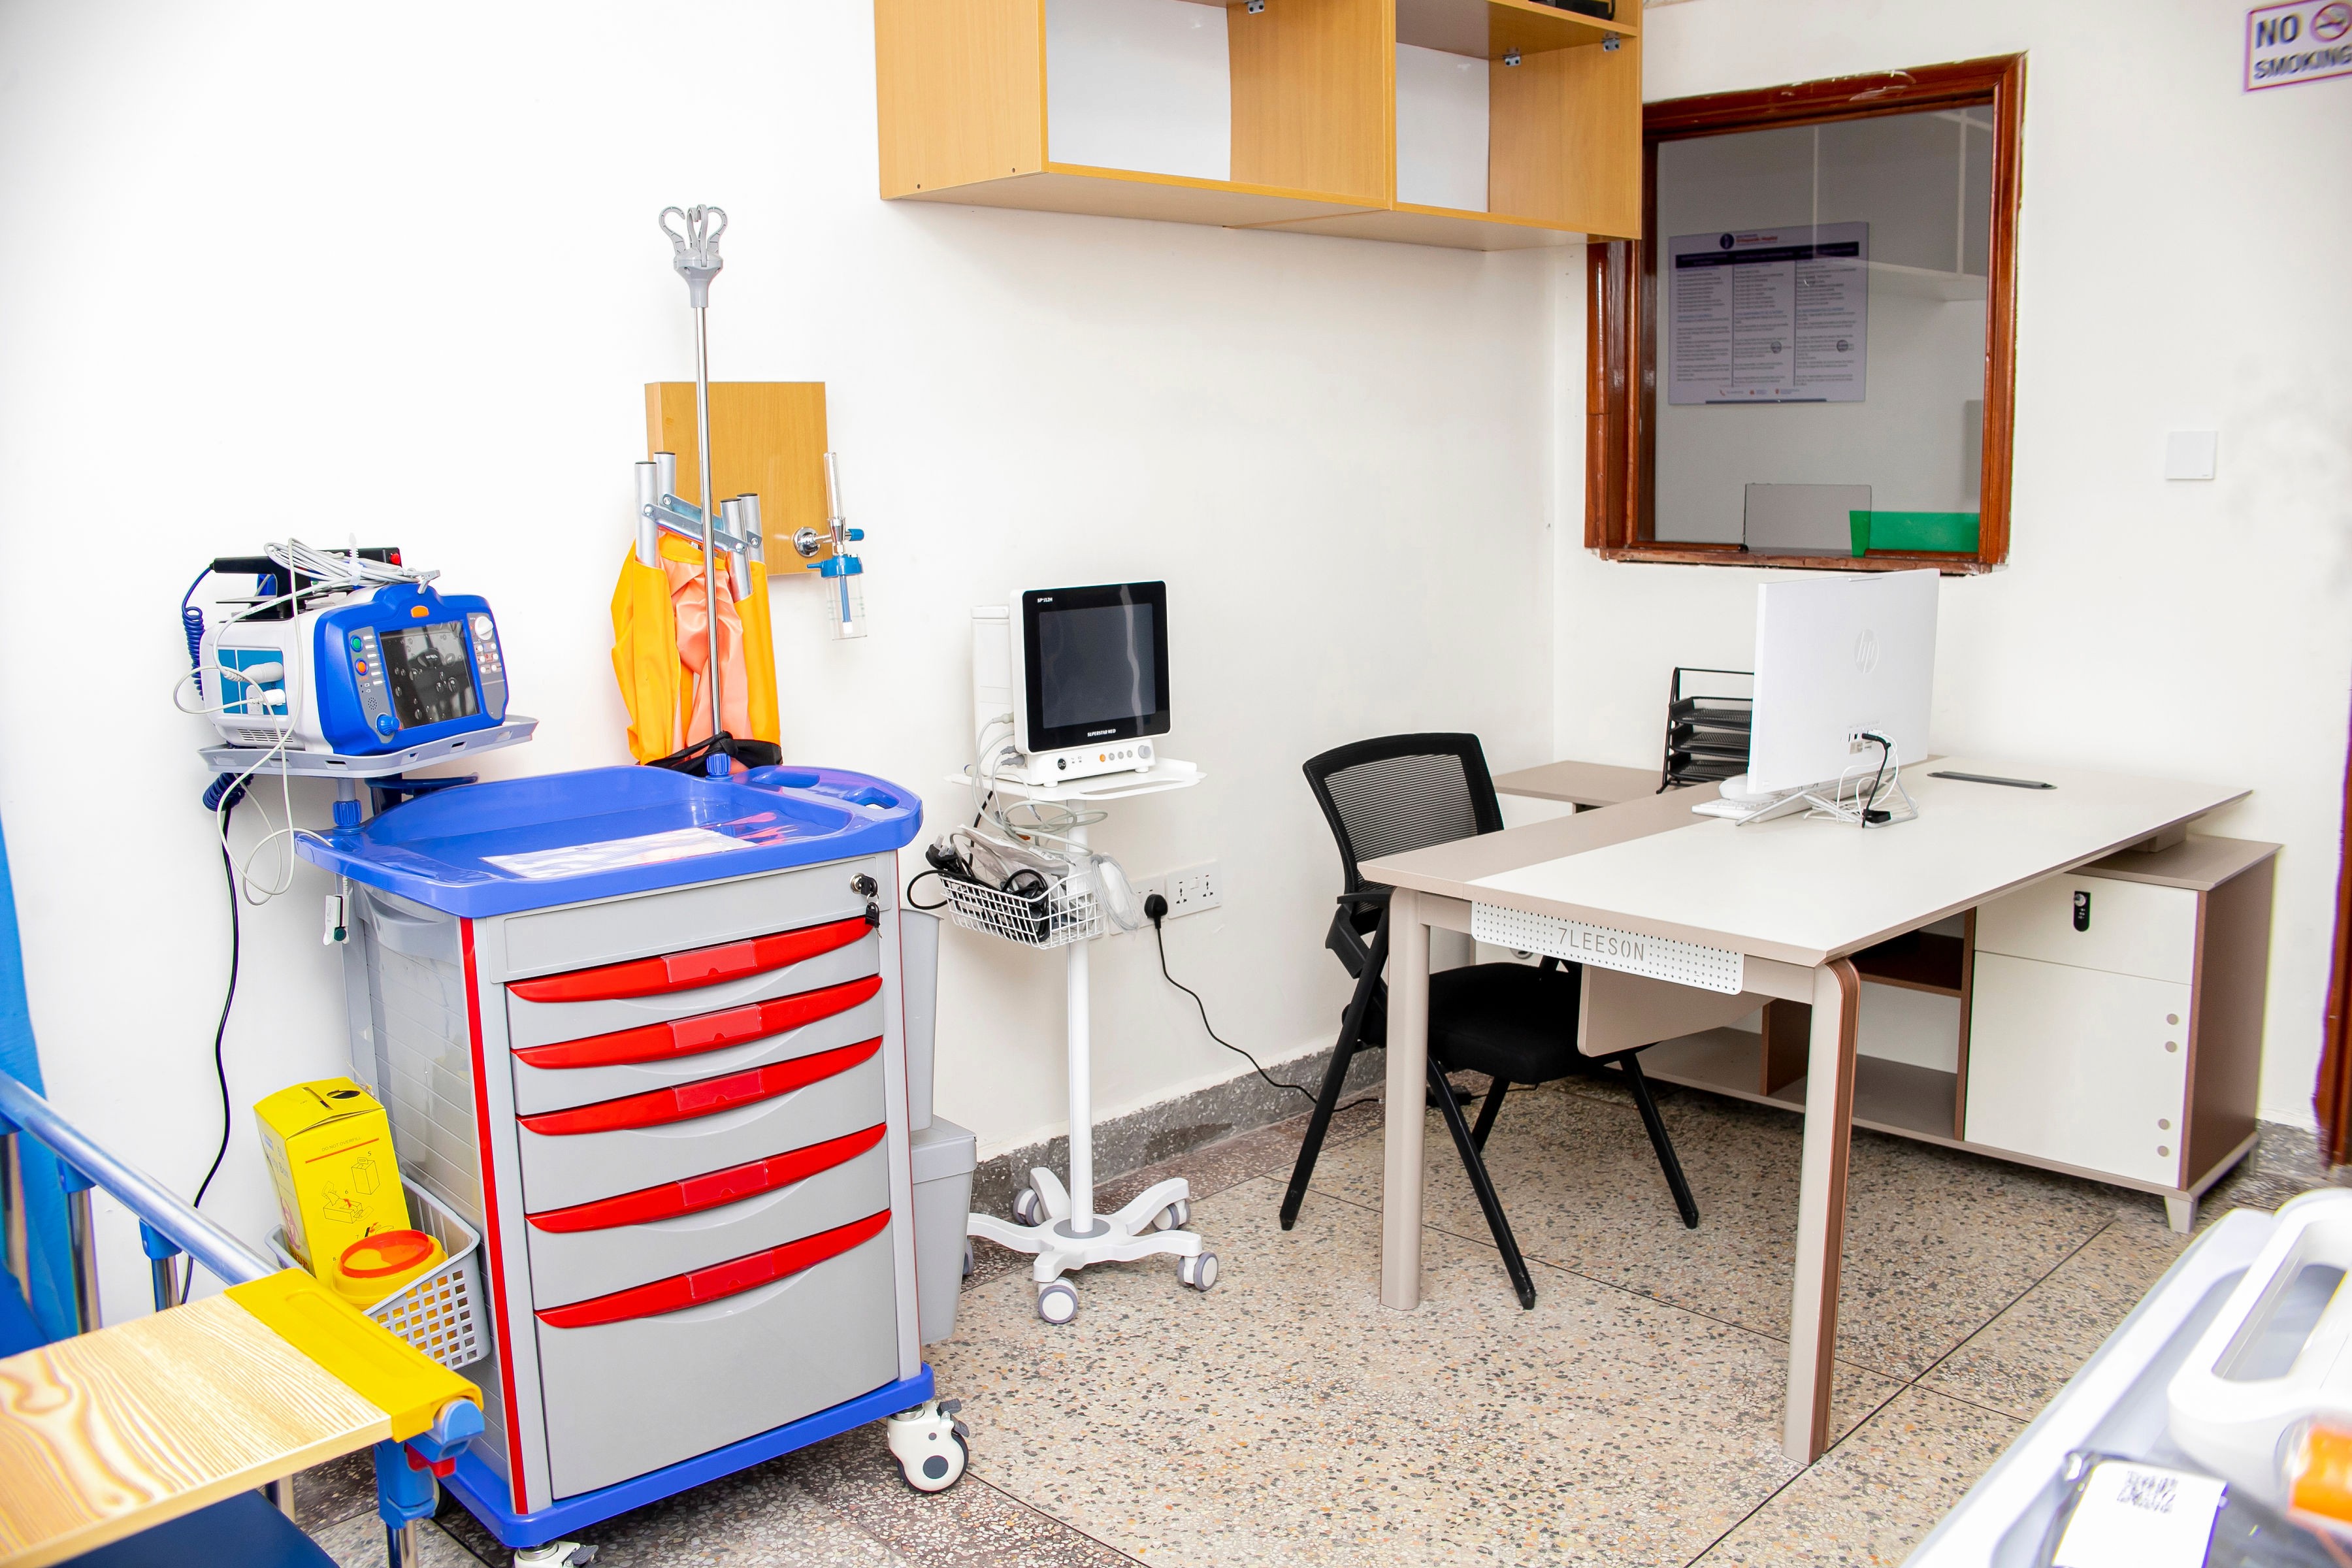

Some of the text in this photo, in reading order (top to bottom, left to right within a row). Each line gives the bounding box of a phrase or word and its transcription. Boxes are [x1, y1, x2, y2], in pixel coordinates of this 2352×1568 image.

[2255, 14, 2300, 50] NO
[2253, 44, 2352, 80] SMOKING
[1855, 629, 1876, 674] hp
[339, 1136, 361, 1146] OVERFILL
